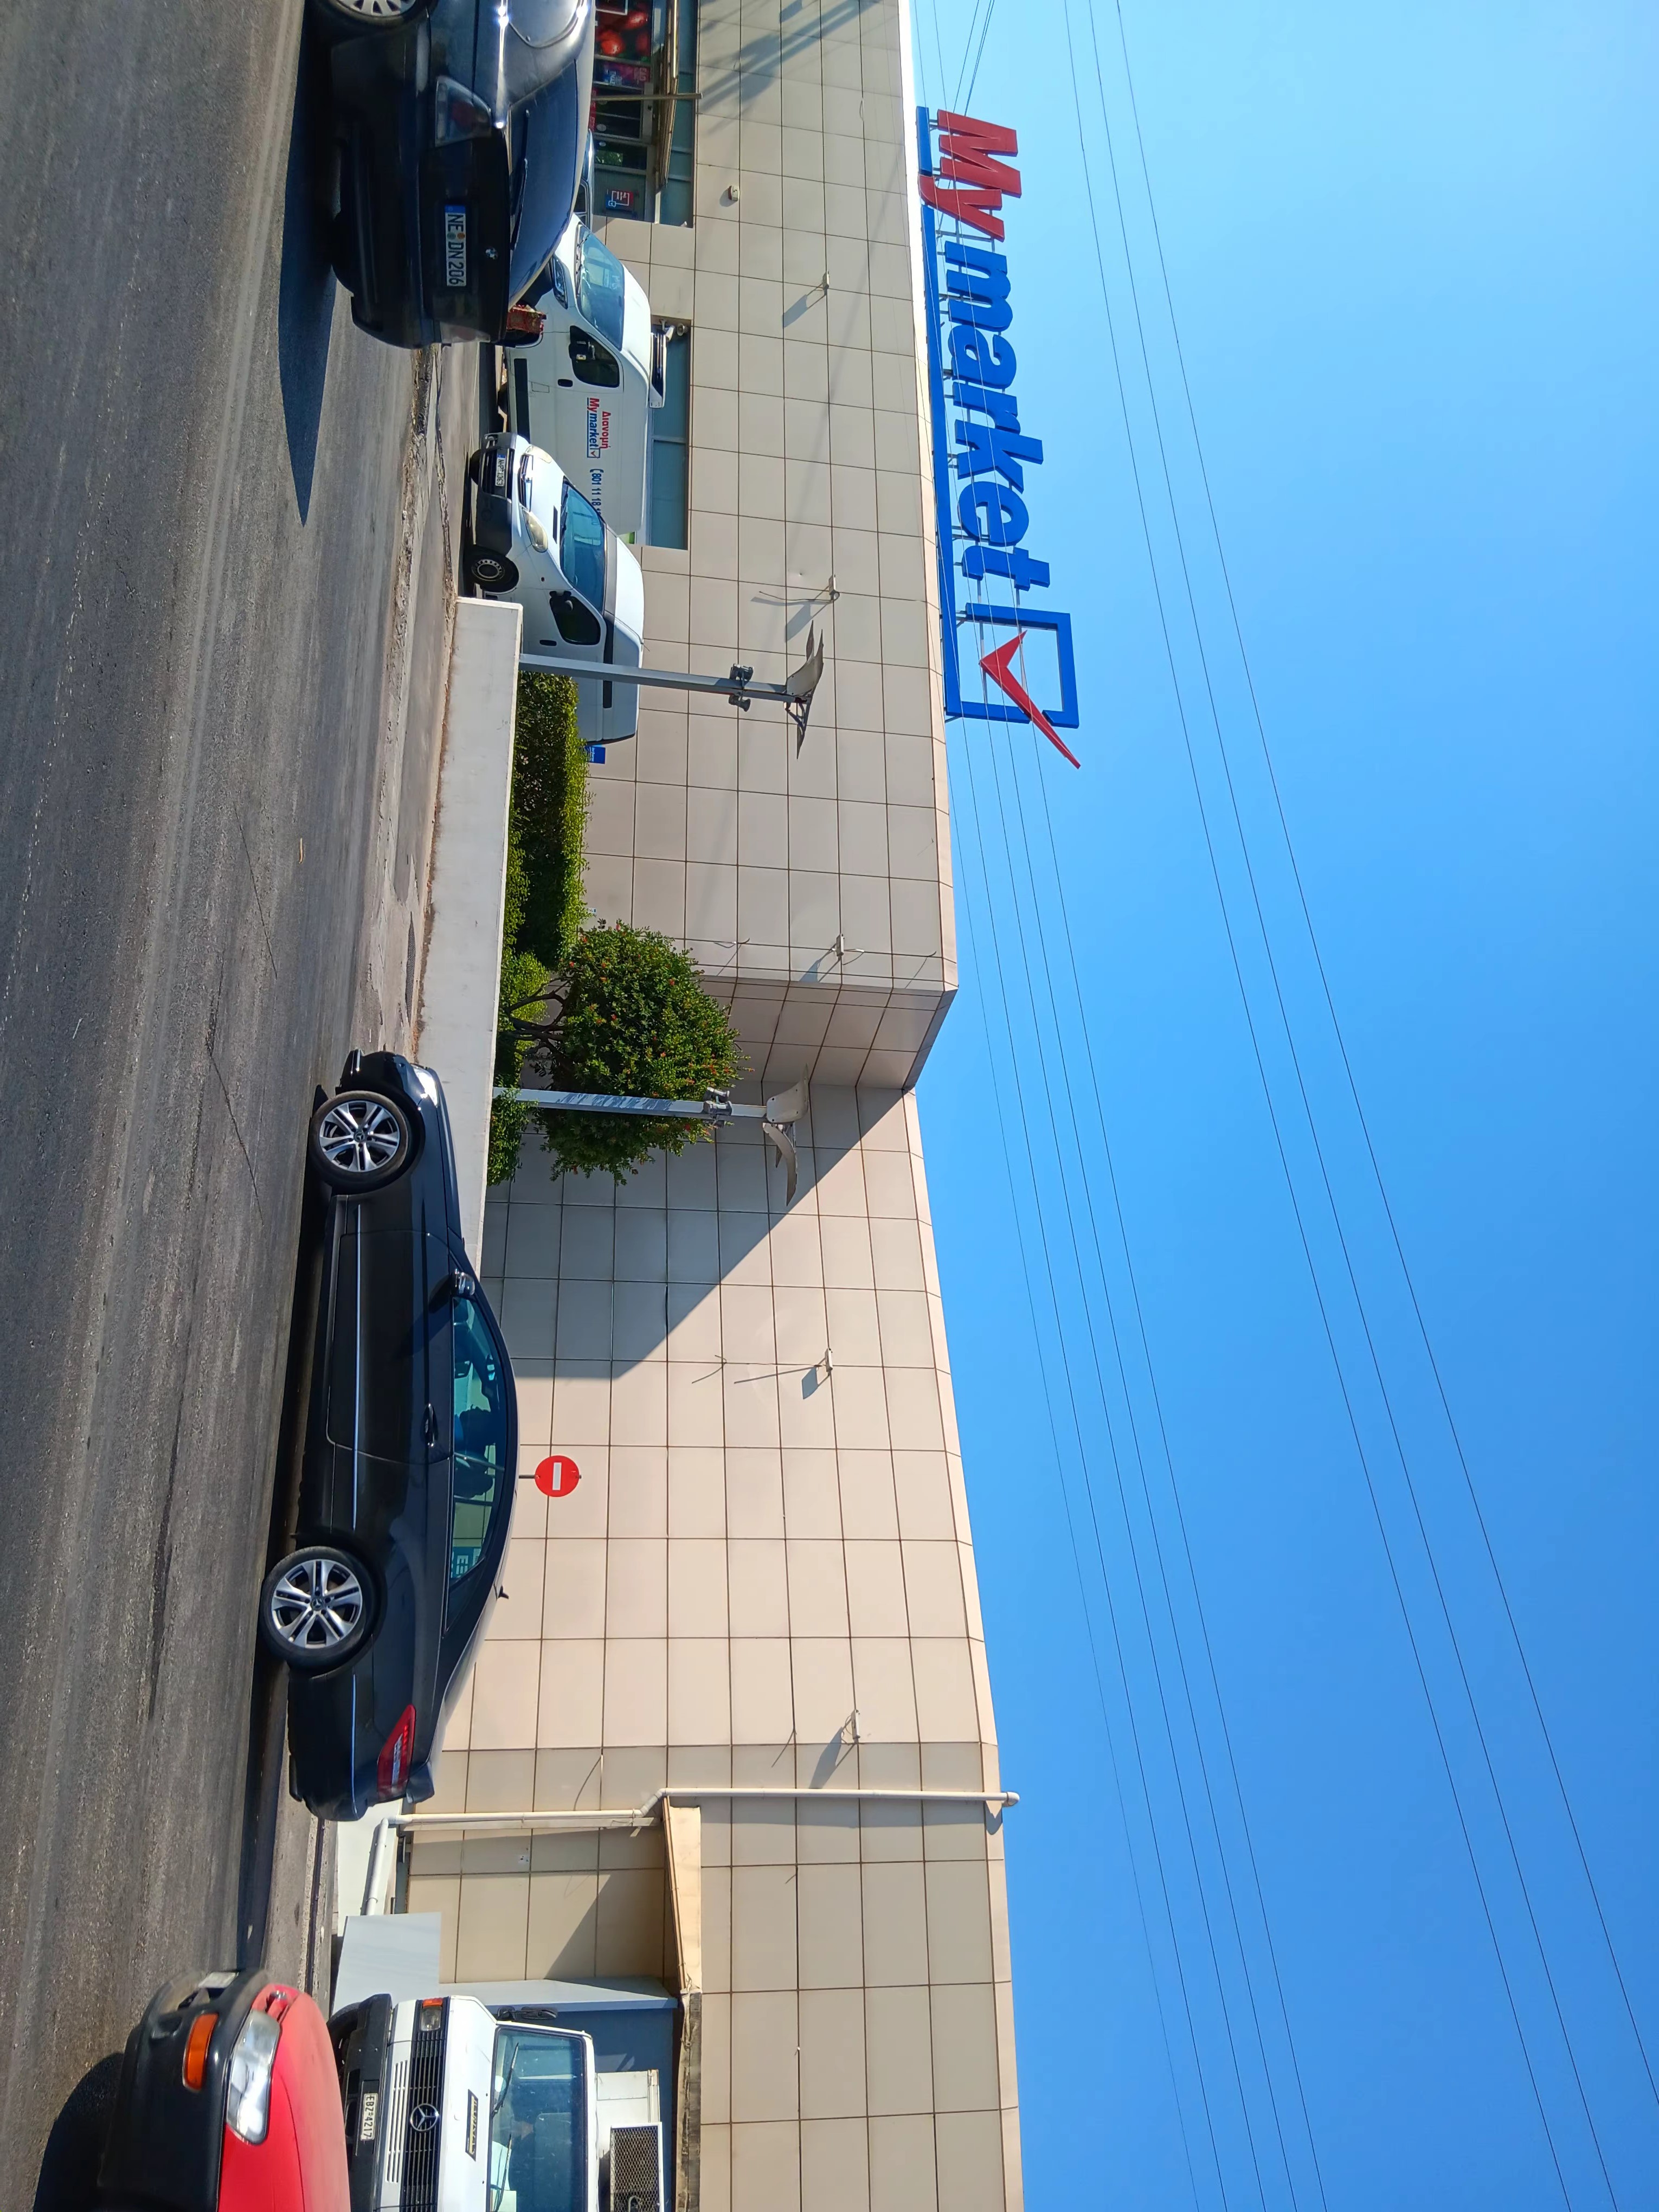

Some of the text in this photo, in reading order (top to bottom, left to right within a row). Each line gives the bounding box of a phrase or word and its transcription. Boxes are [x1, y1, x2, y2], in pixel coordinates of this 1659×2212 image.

[448, 215, 465, 285] NE DN 206
[918, 109, 1051, 591] My market
[587, 397, 600, 447] My market
[600, 411, 611, 449] Διανομή
[591, 473, 602, 485] 801
[591, 498, 601, 506] 18
